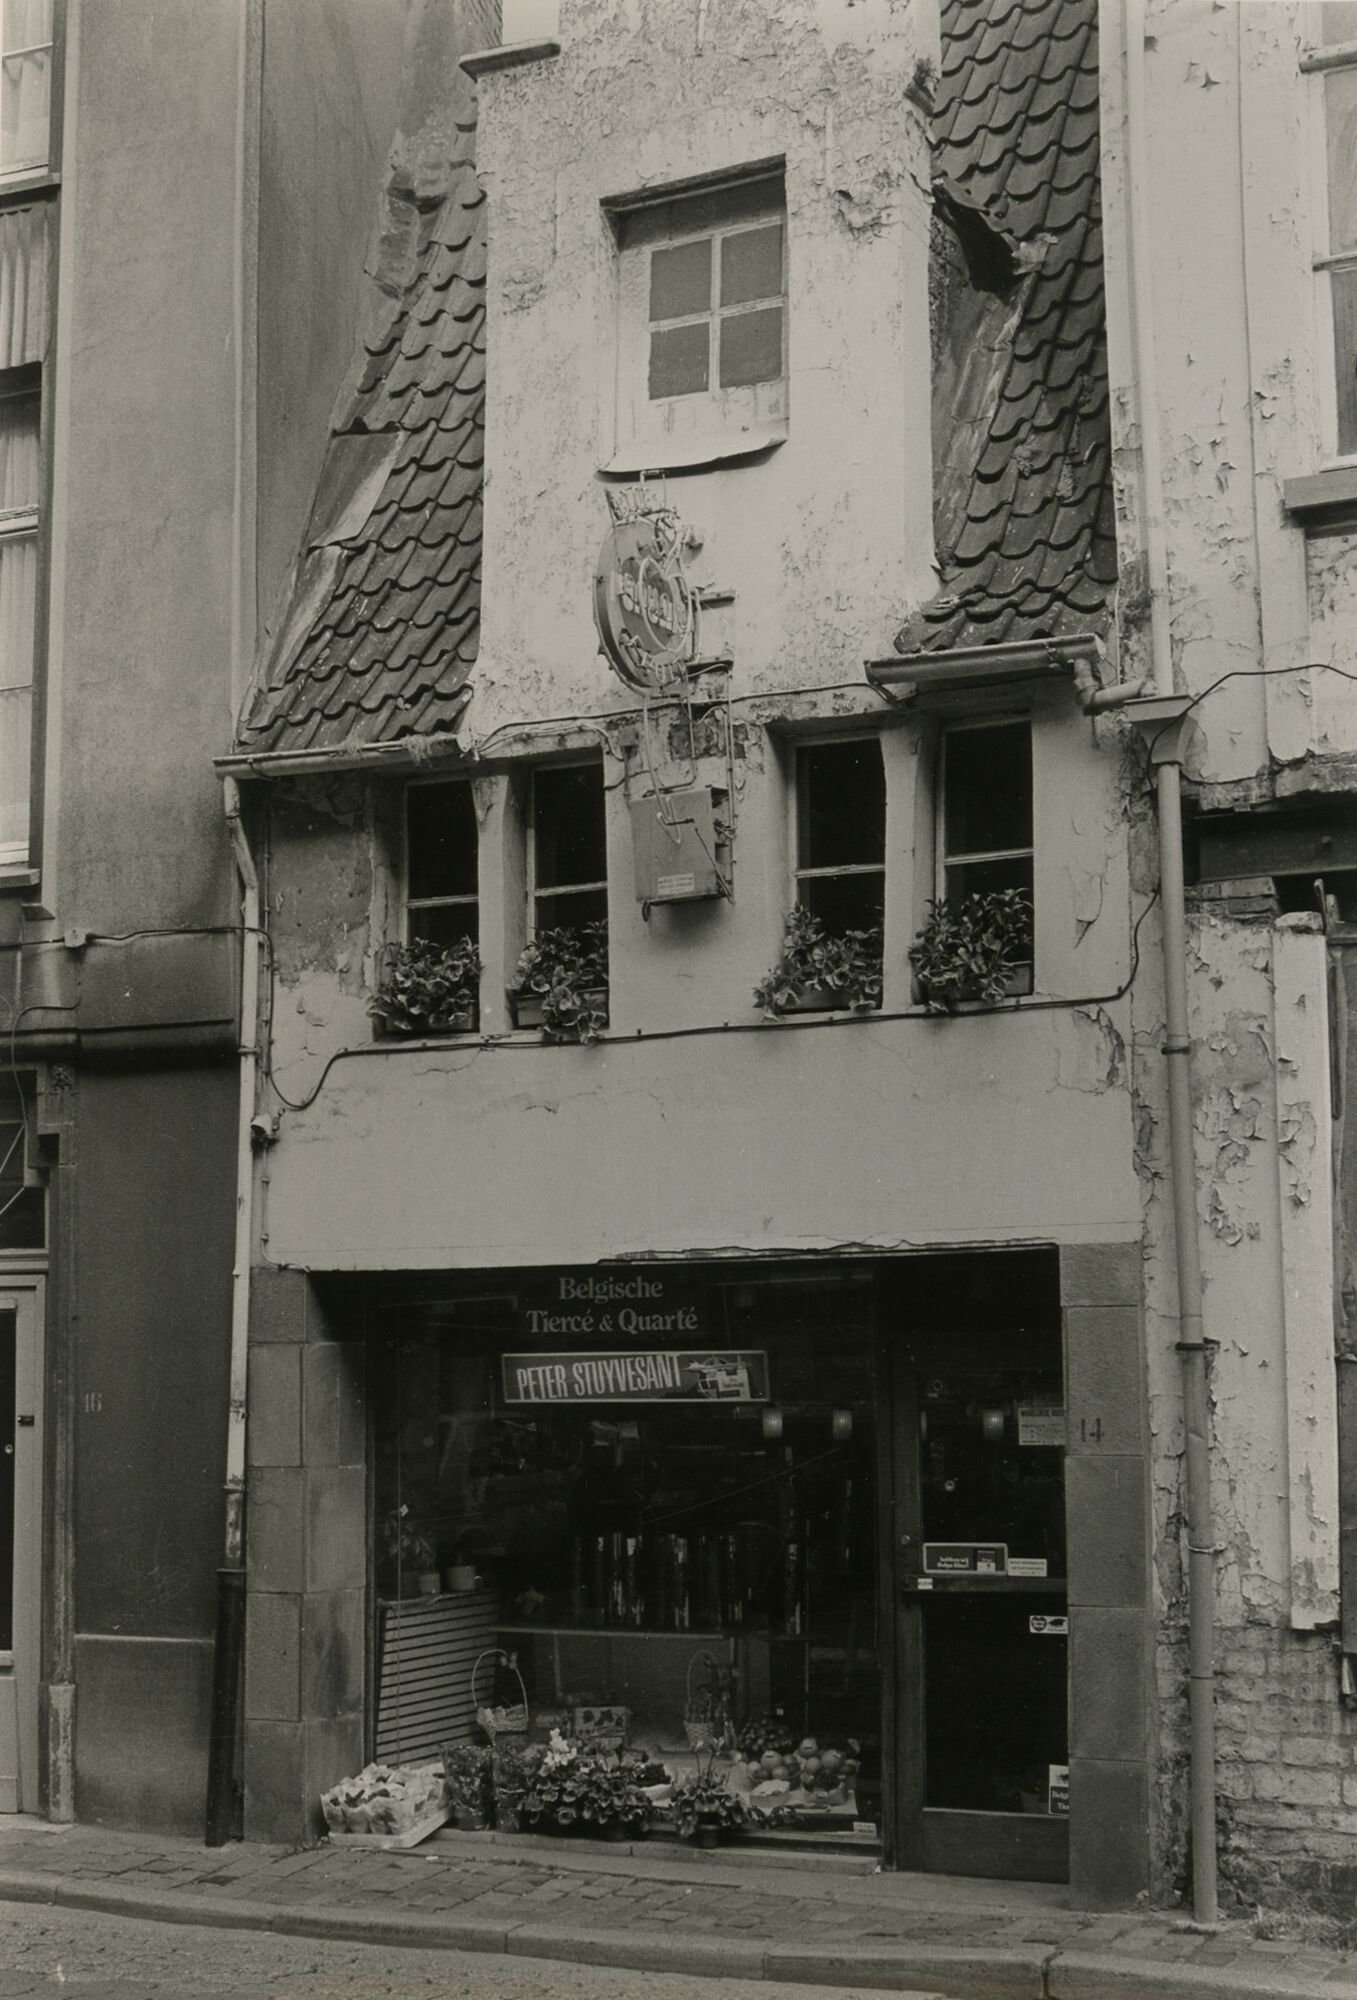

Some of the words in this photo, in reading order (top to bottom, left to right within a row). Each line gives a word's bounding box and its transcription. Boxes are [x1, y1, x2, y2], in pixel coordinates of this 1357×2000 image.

[558, 1275, 664, 1304] Belgische
[526, 1309, 594, 1334] Tiercé
[599, 1313, 613, 1332] &
[617, 1306, 699, 1335] Quarté
[516, 1363, 569, 1401] PETER
[573, 1354, 682, 1397] STUYVESANT
[84, 1391, 102, 1413] 16
[1081, 1417, 1105, 1442] 14
